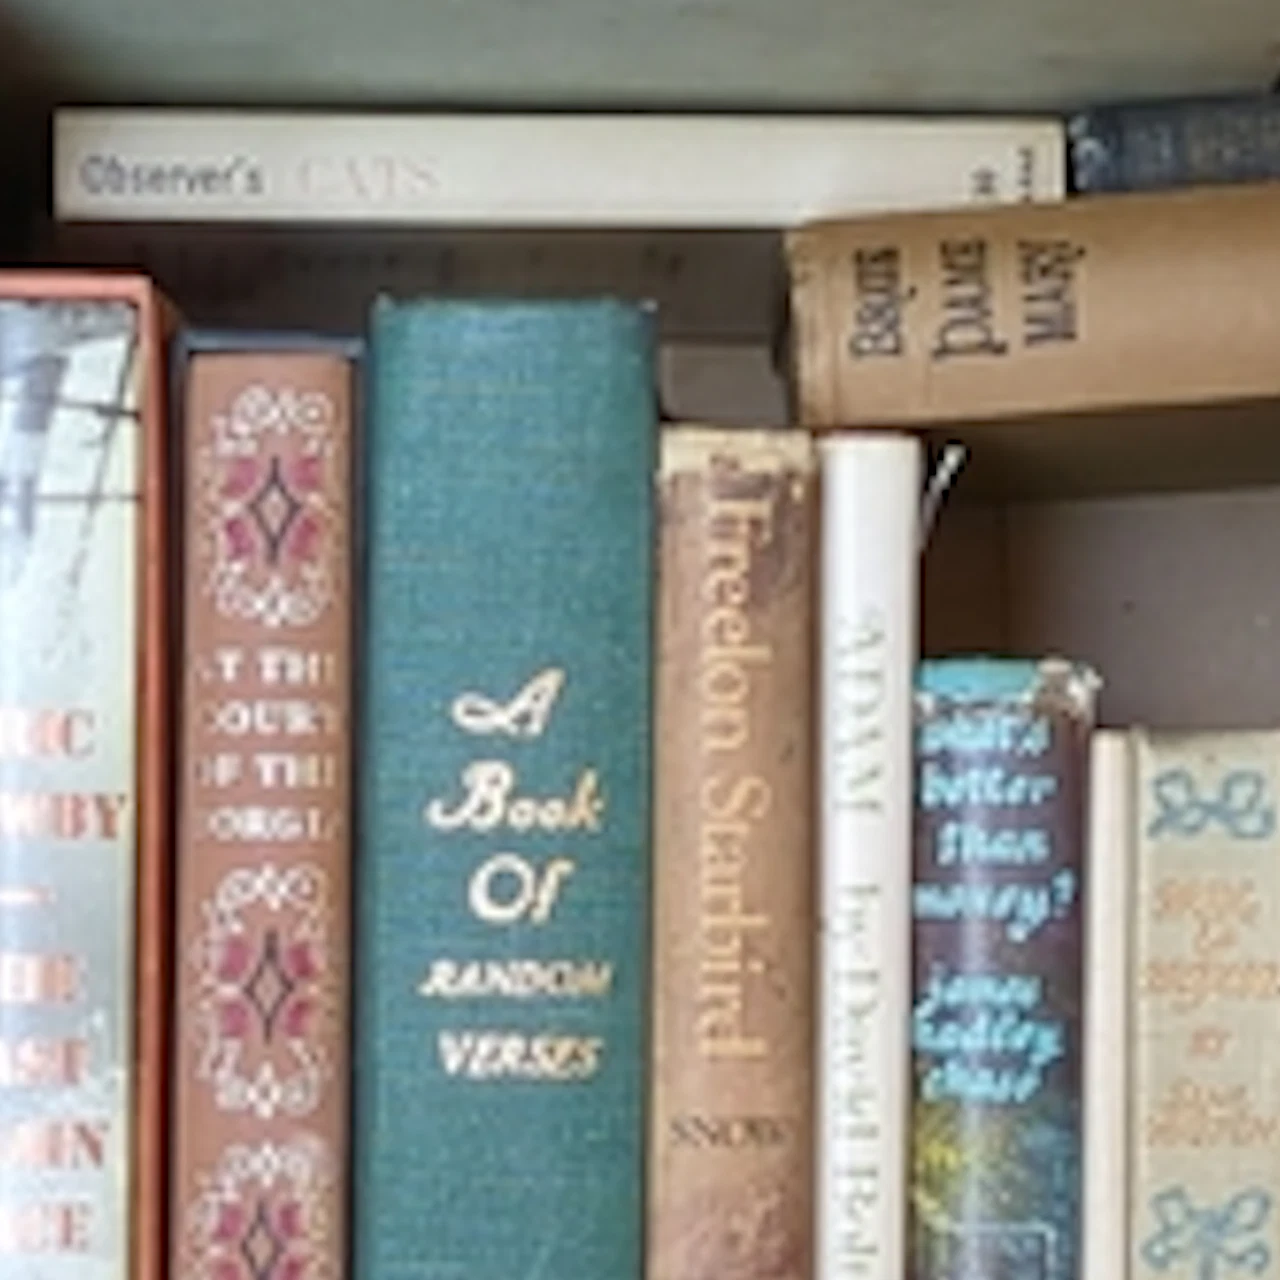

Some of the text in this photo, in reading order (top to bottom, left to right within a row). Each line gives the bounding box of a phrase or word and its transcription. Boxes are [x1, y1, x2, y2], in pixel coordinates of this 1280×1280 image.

[78, 155, 265, 195] Observer's
[451, 667, 567, 737] A
[831, 605, 885, 810] ADAM
[426, 759, 604, 831] Book
[699, 500, 773, 1063] Freelon Starbird
[467, 852, 576, 923] Of
[419, 958, 611, 999] RANDOM
[438, 1030, 604, 1080] VERSES
